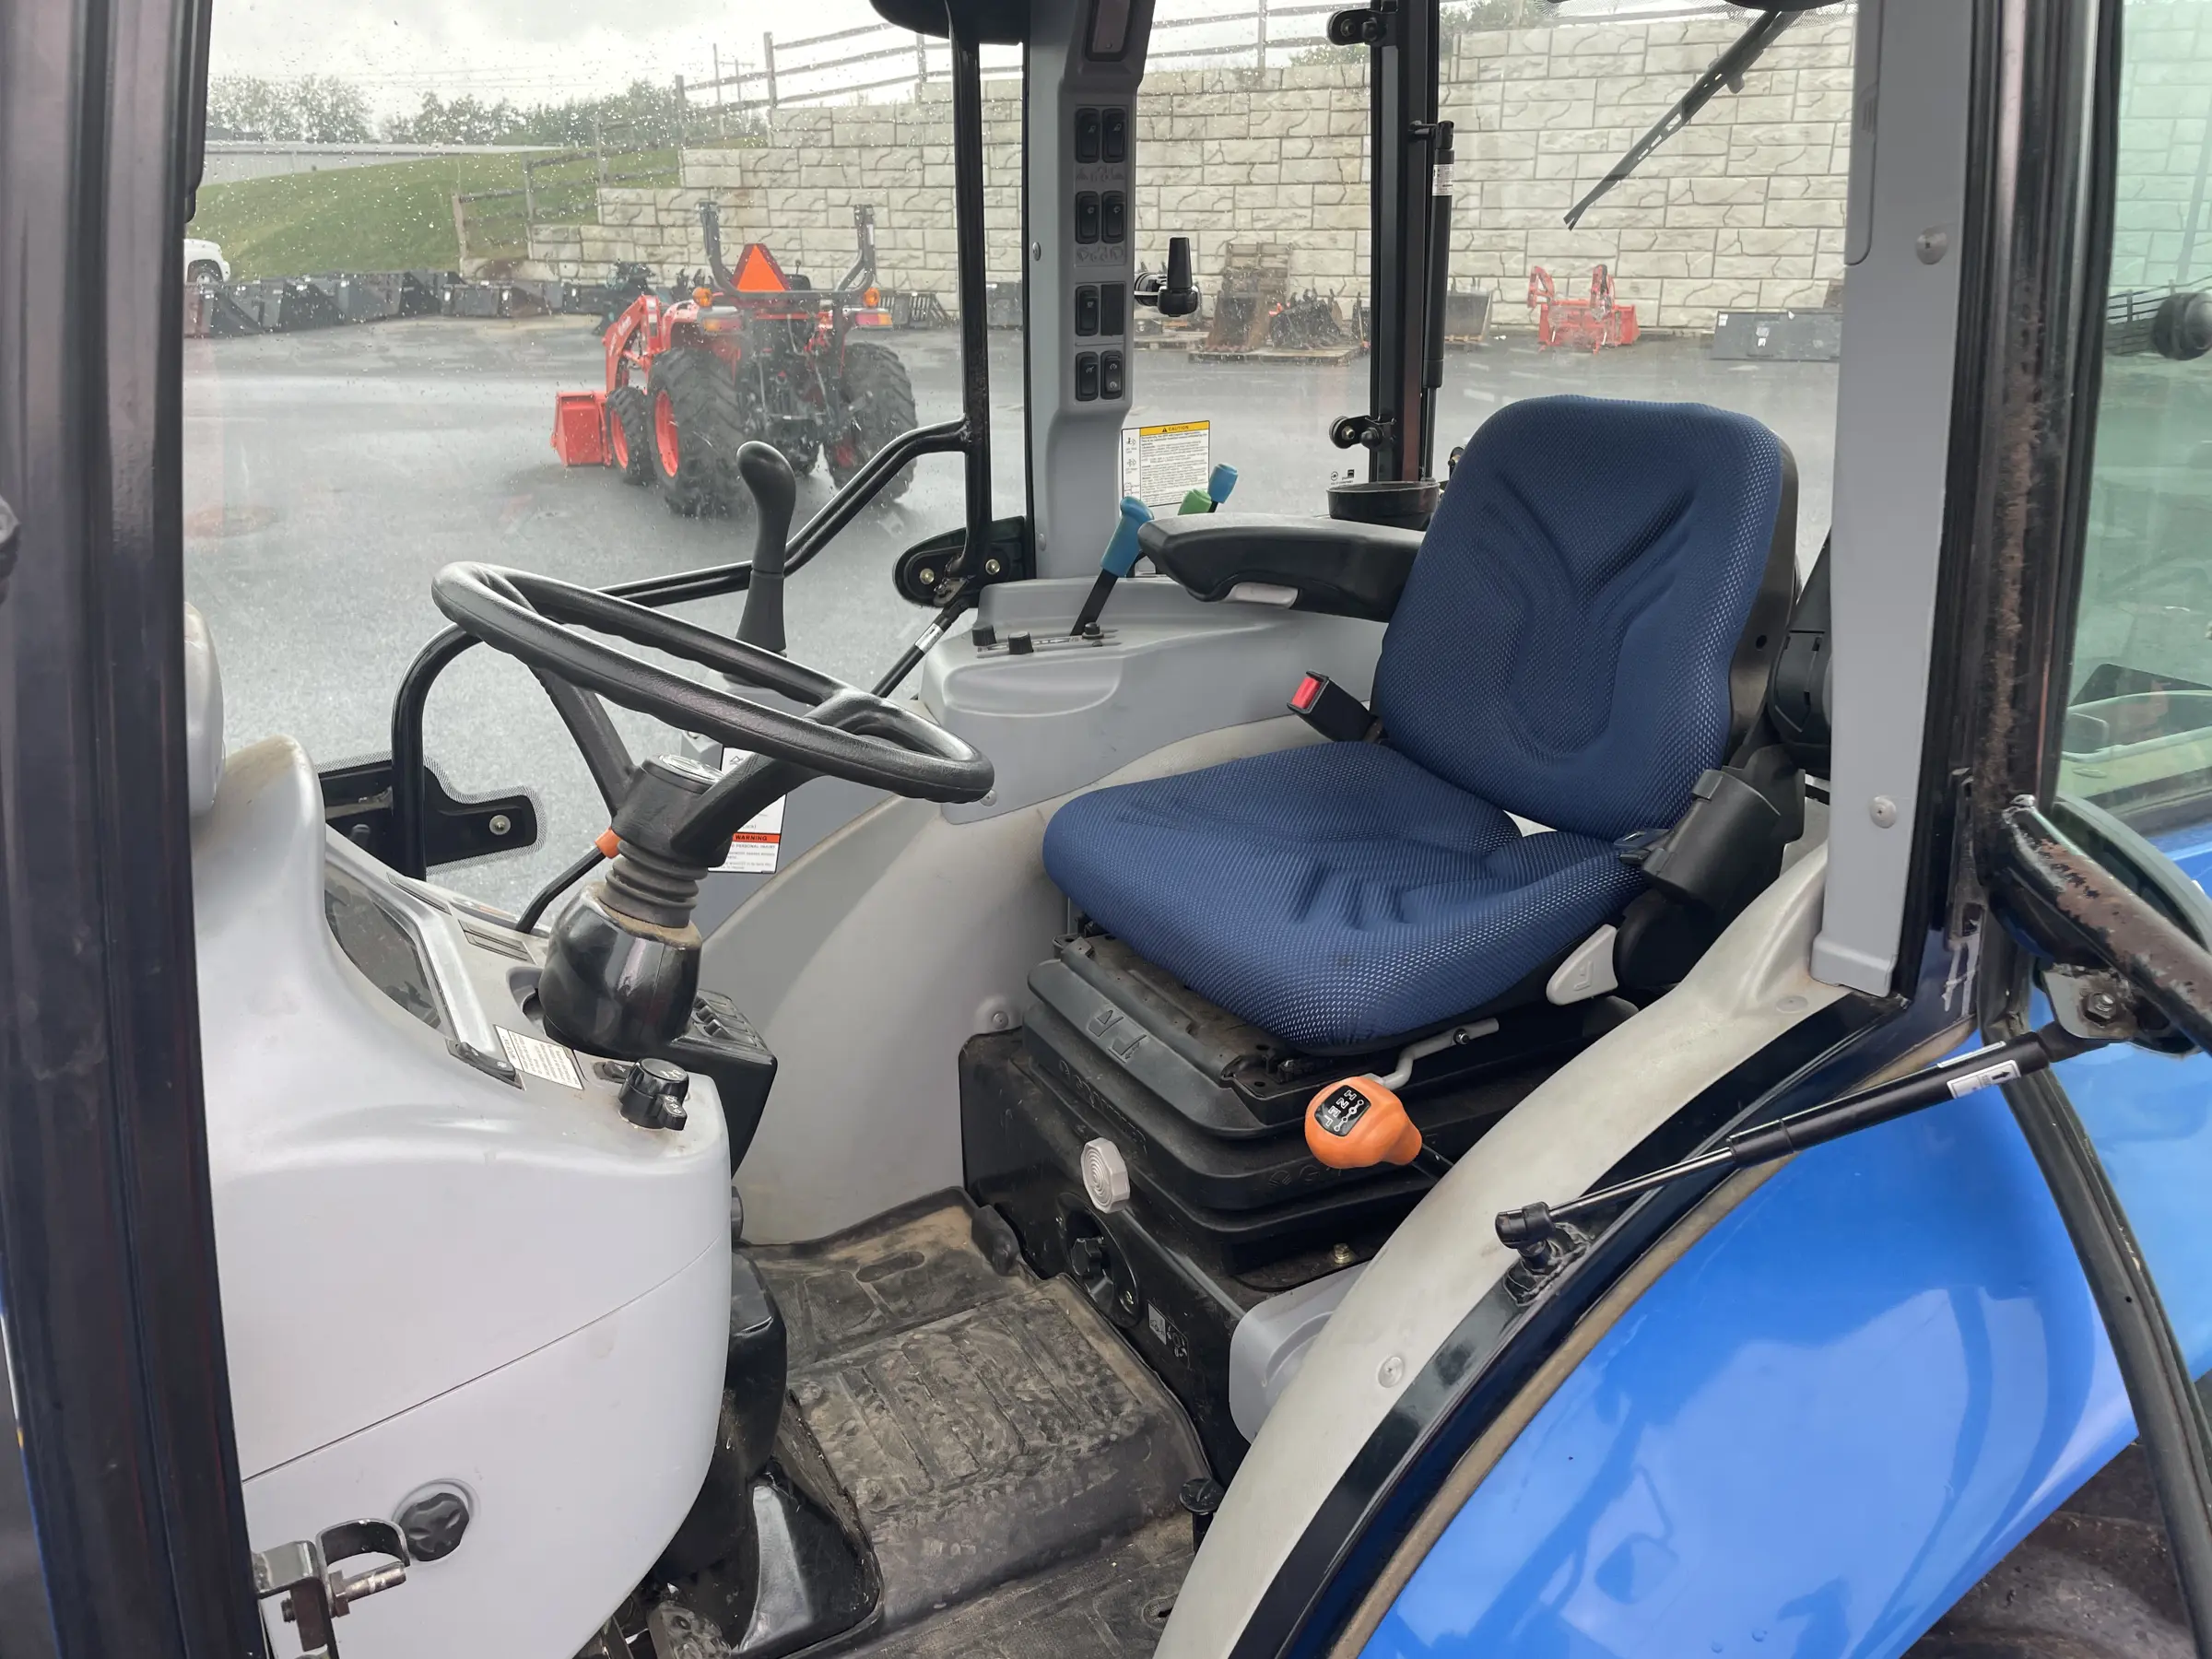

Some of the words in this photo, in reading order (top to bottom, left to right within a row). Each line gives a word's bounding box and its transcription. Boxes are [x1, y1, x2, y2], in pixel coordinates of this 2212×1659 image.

[1343, 1089, 1358, 1100] H
[1335, 1098, 1349, 1109] N
[1324, 1114, 1334, 1127] L
